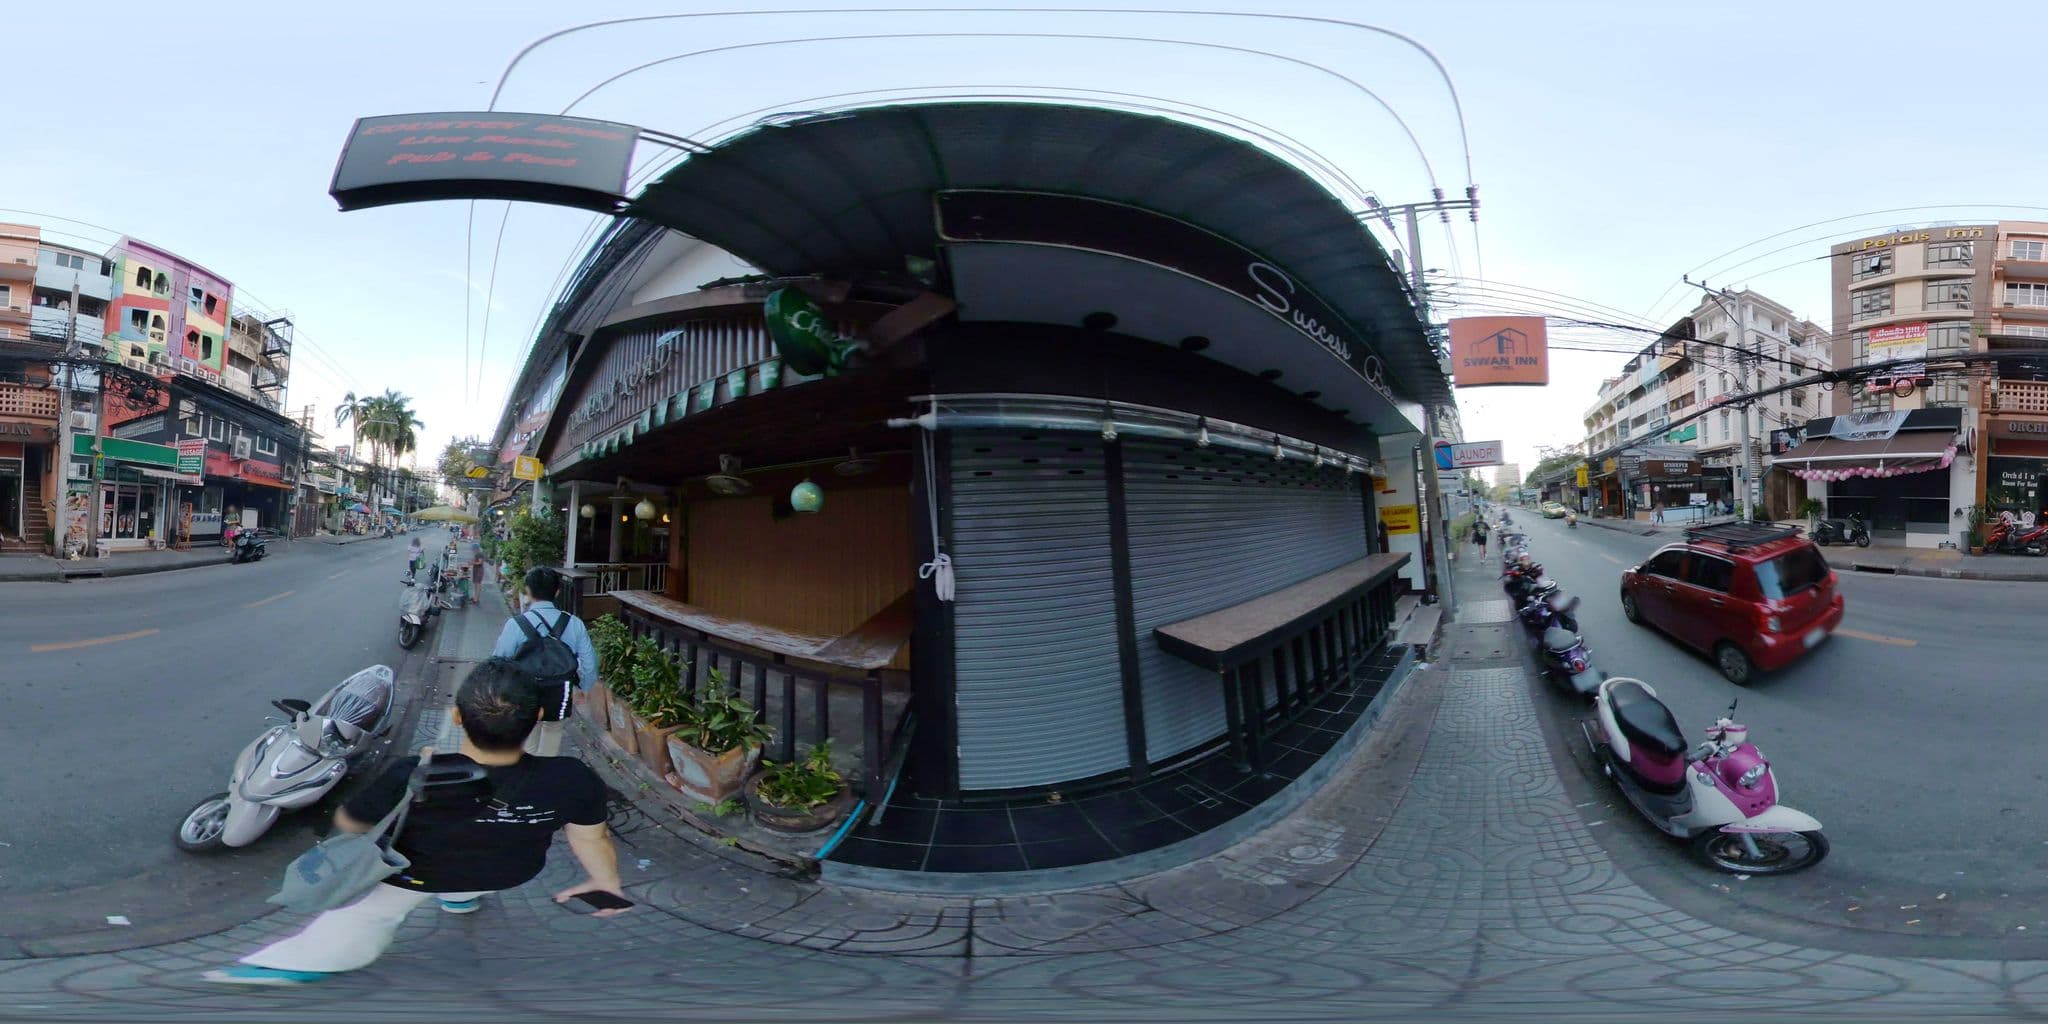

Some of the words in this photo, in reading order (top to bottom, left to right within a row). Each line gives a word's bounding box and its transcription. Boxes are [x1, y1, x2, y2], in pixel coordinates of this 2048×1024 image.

[1863, 232, 1930, 250] Petals
[1945, 228, 1983, 239] Inn
[1248, 262, 1351, 360] Success
[1515, 356, 1538, 366] INN
[11, 423, 32, 435] INN
